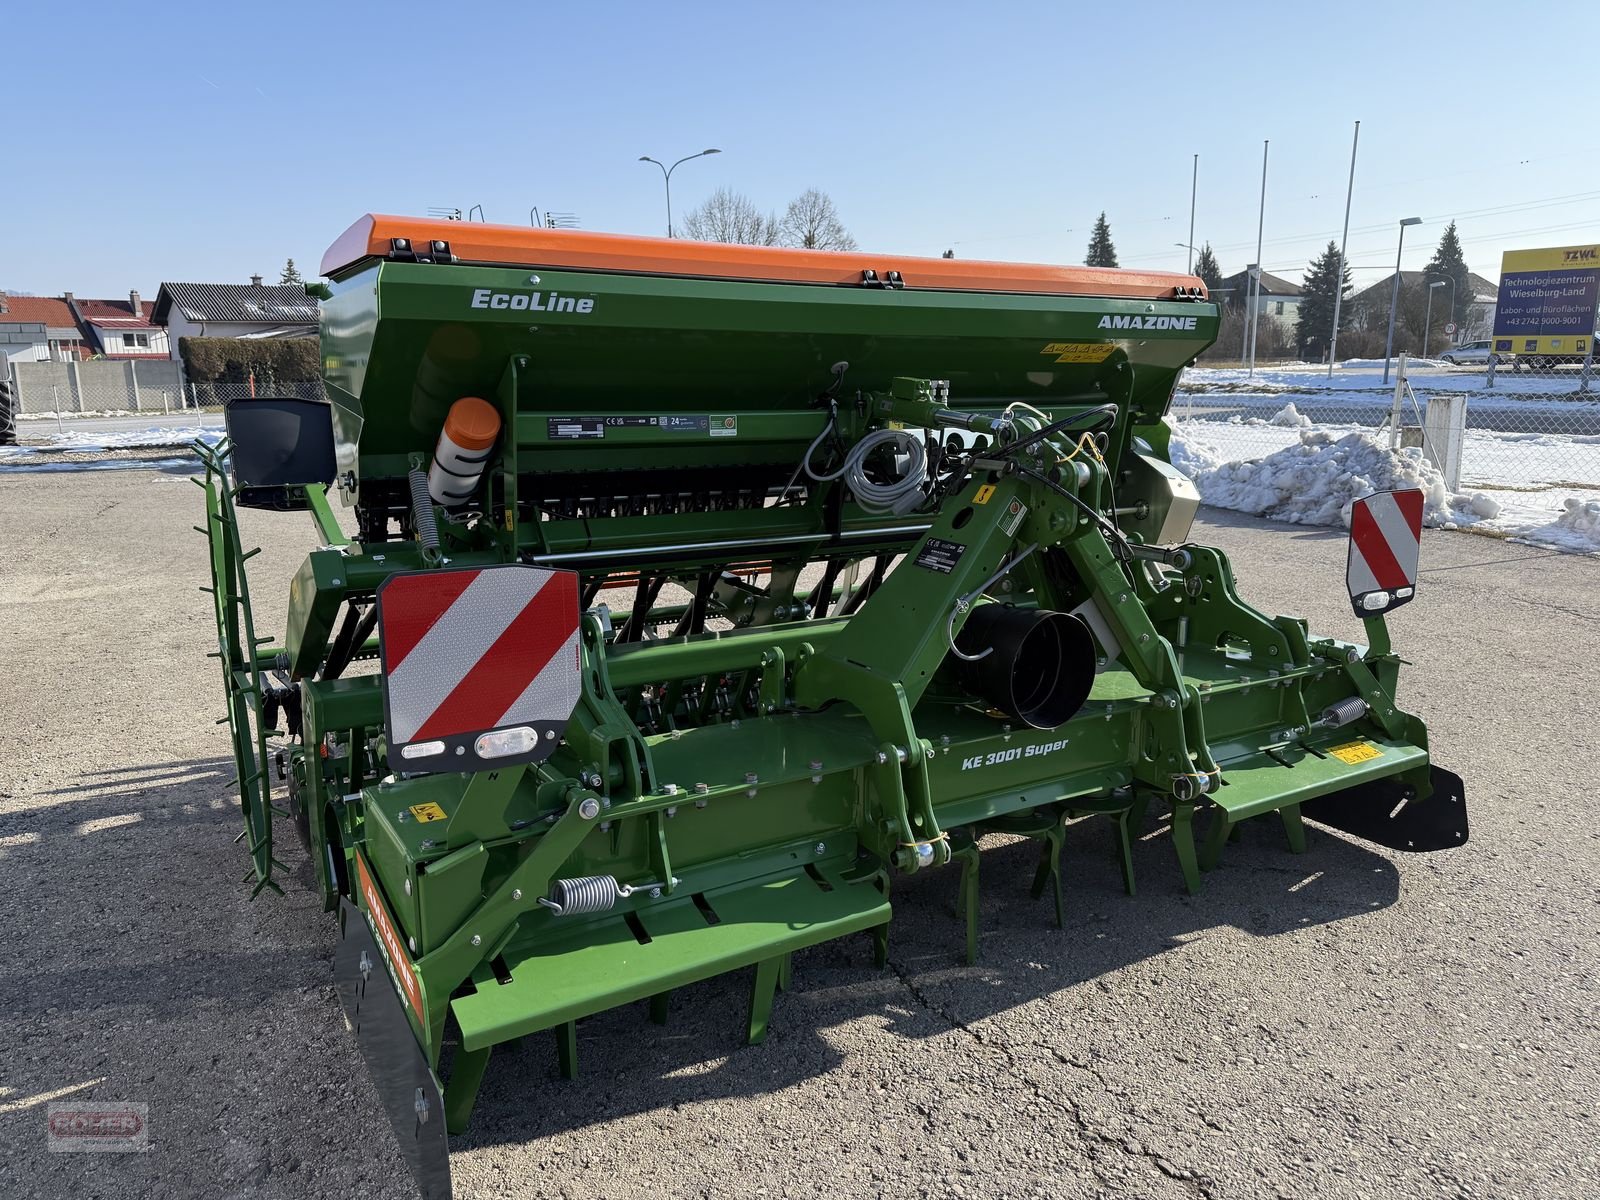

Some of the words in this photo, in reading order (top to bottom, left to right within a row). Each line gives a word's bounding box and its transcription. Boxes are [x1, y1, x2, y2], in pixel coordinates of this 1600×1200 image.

[1566, 249, 1596, 260] TZWL
[1504, 275, 1595, 287] Technologiezentrum
[1509, 287, 1585, 298] Wieselburg-Land
[471, 288, 594, 314] EcoLine
[1500, 306, 1524, 314] Labor-
[1526, 306, 1541, 314] und
[1542, 305, 1591, 314] Büroflächen
[1097, 315, 1197, 330] AMAZONE
[1521, 317, 1539, 325] 2742
[1541, 317, 1581, 325] 9000-9001
[671, 417, 680, 425] 24
[961, 755, 983, 771] KE
[985, 747, 1022, 766] 3001
[1024, 739, 1069, 757] Super
[367, 885, 415, 997] AMAZONE
